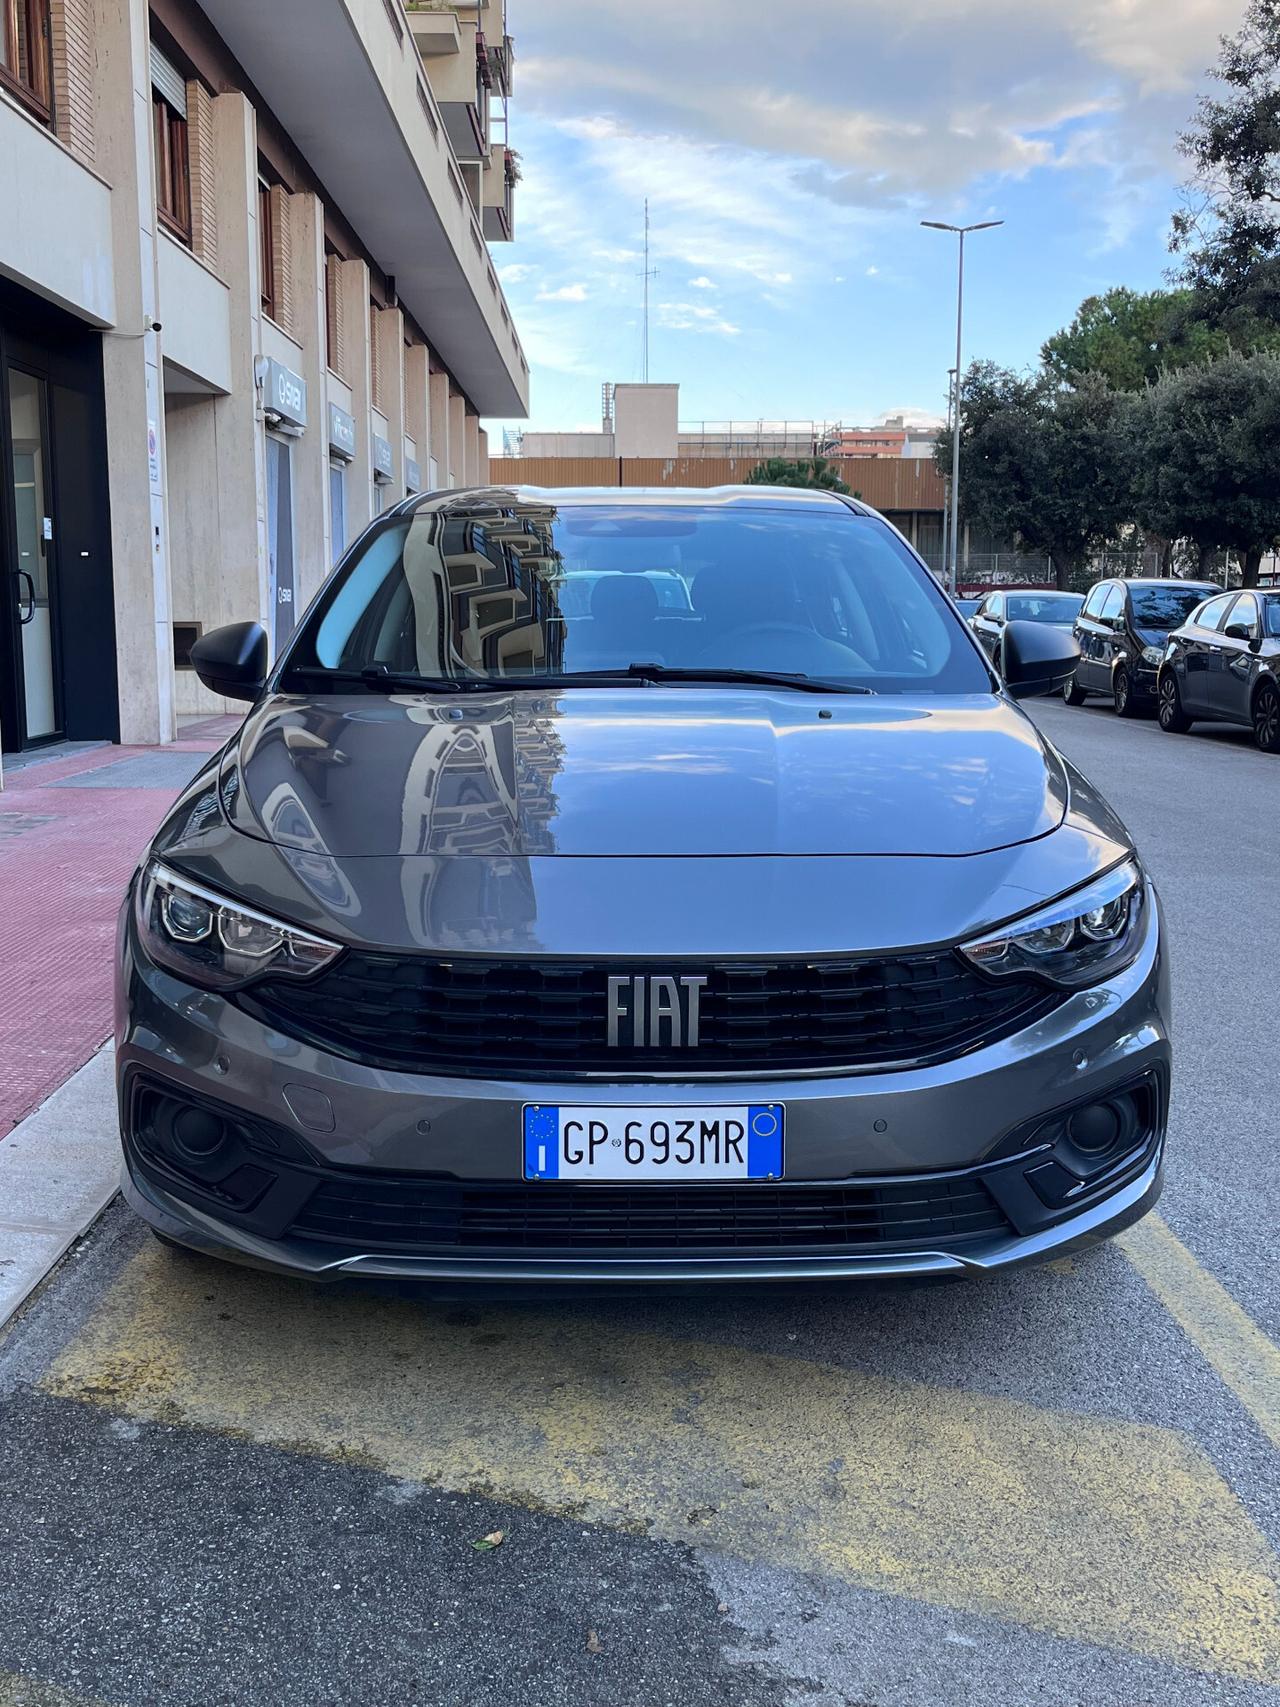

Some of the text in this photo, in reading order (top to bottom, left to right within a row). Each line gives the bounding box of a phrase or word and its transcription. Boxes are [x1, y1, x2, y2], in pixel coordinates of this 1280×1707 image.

[608, 976, 708, 1047] FIAT
[563, 1120, 745, 1165] GP 693MR
